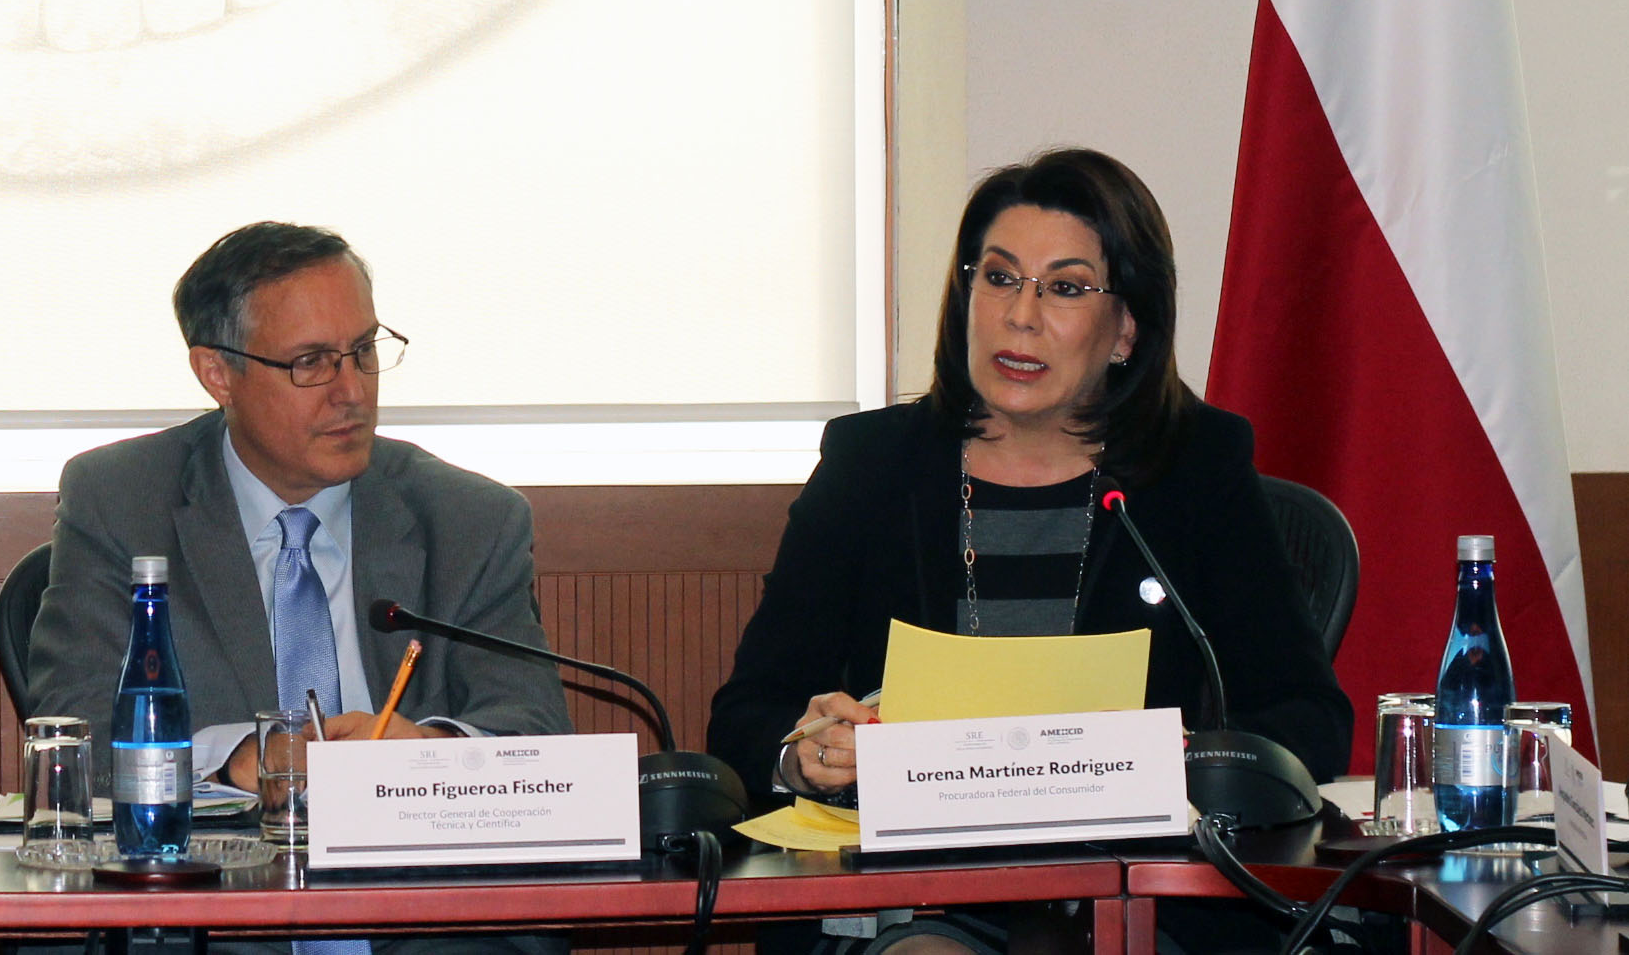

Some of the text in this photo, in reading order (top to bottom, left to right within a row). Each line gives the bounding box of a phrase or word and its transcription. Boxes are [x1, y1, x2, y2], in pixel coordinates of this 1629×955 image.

[1193, 750, 1258, 761] SENNHEISER
[650, 770, 711, 781] SENNHEISER
[907, 758, 1135, 783] Lorena Martínez Rodriguez
[376, 779, 574, 800] Bruno Figueroa Fischer
[938, 784, 1105, 801] Procuradora Federal del Consumidor
[398, 807, 552, 820] Director General de Cooperación
[430, 819, 521, 831] Técnica y Científica
